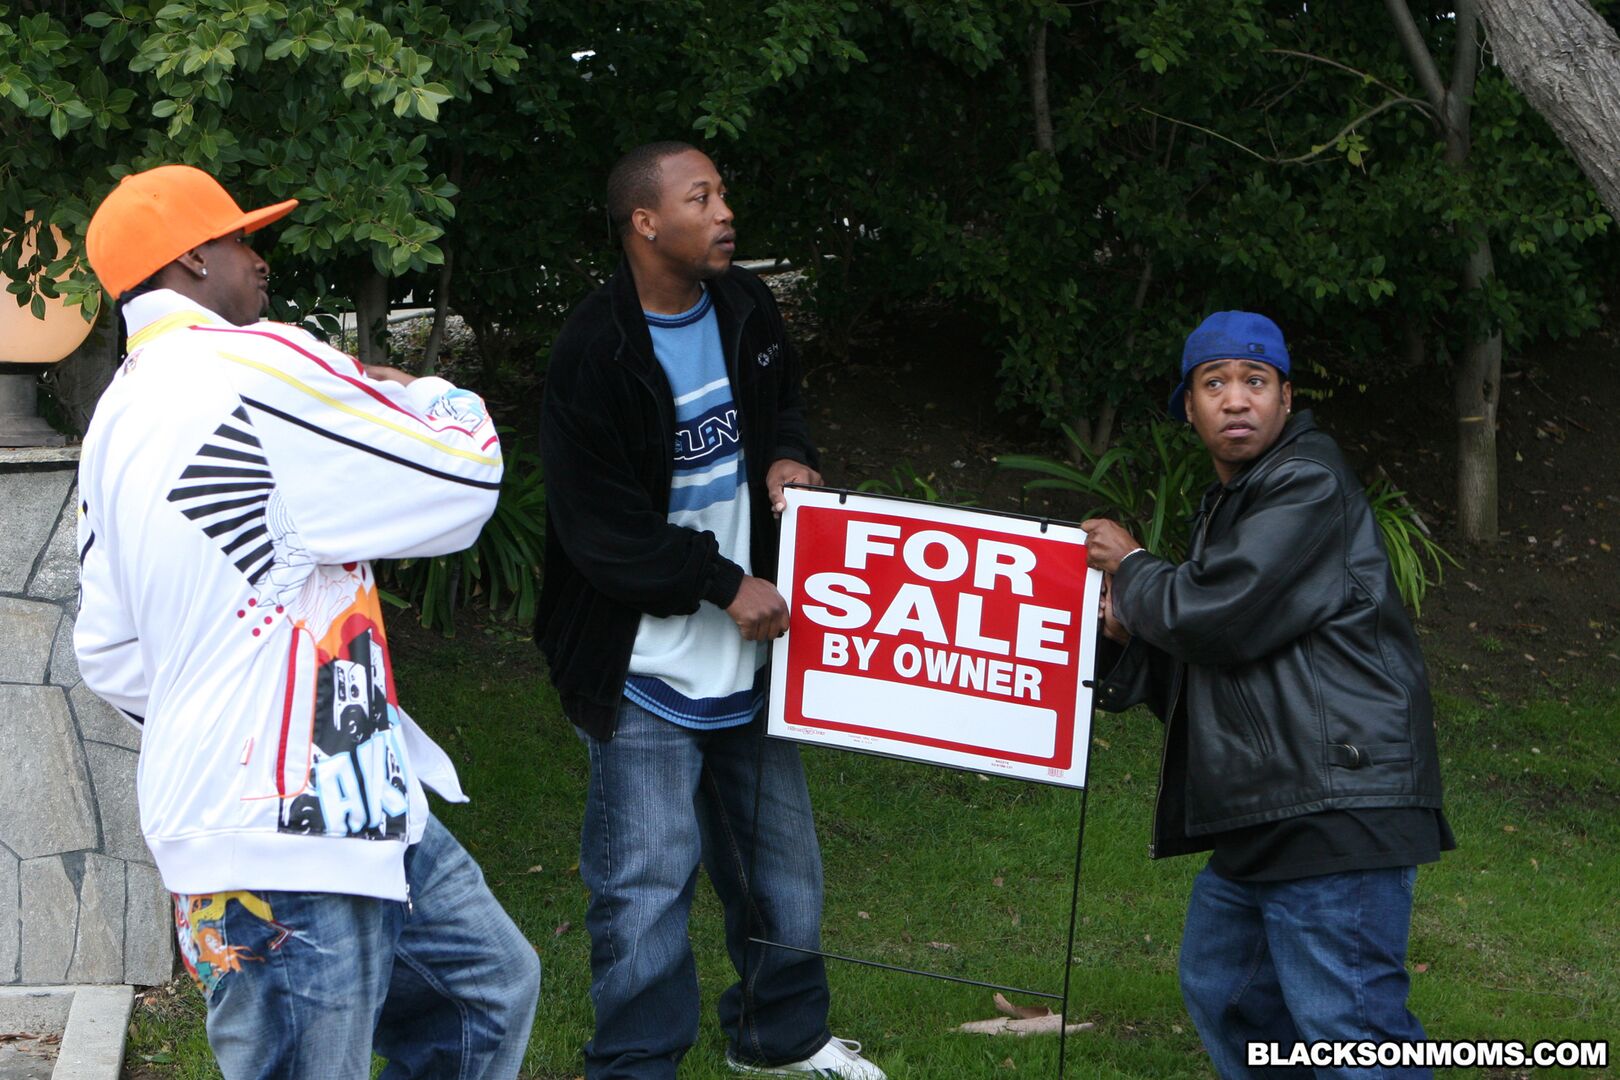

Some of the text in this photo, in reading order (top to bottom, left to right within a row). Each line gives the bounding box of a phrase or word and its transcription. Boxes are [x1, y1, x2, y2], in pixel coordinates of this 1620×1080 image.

[844, 519, 1037, 597] FOR
[801, 572, 1072, 666] SALE
[821, 632, 1043, 701] BY OWNER
